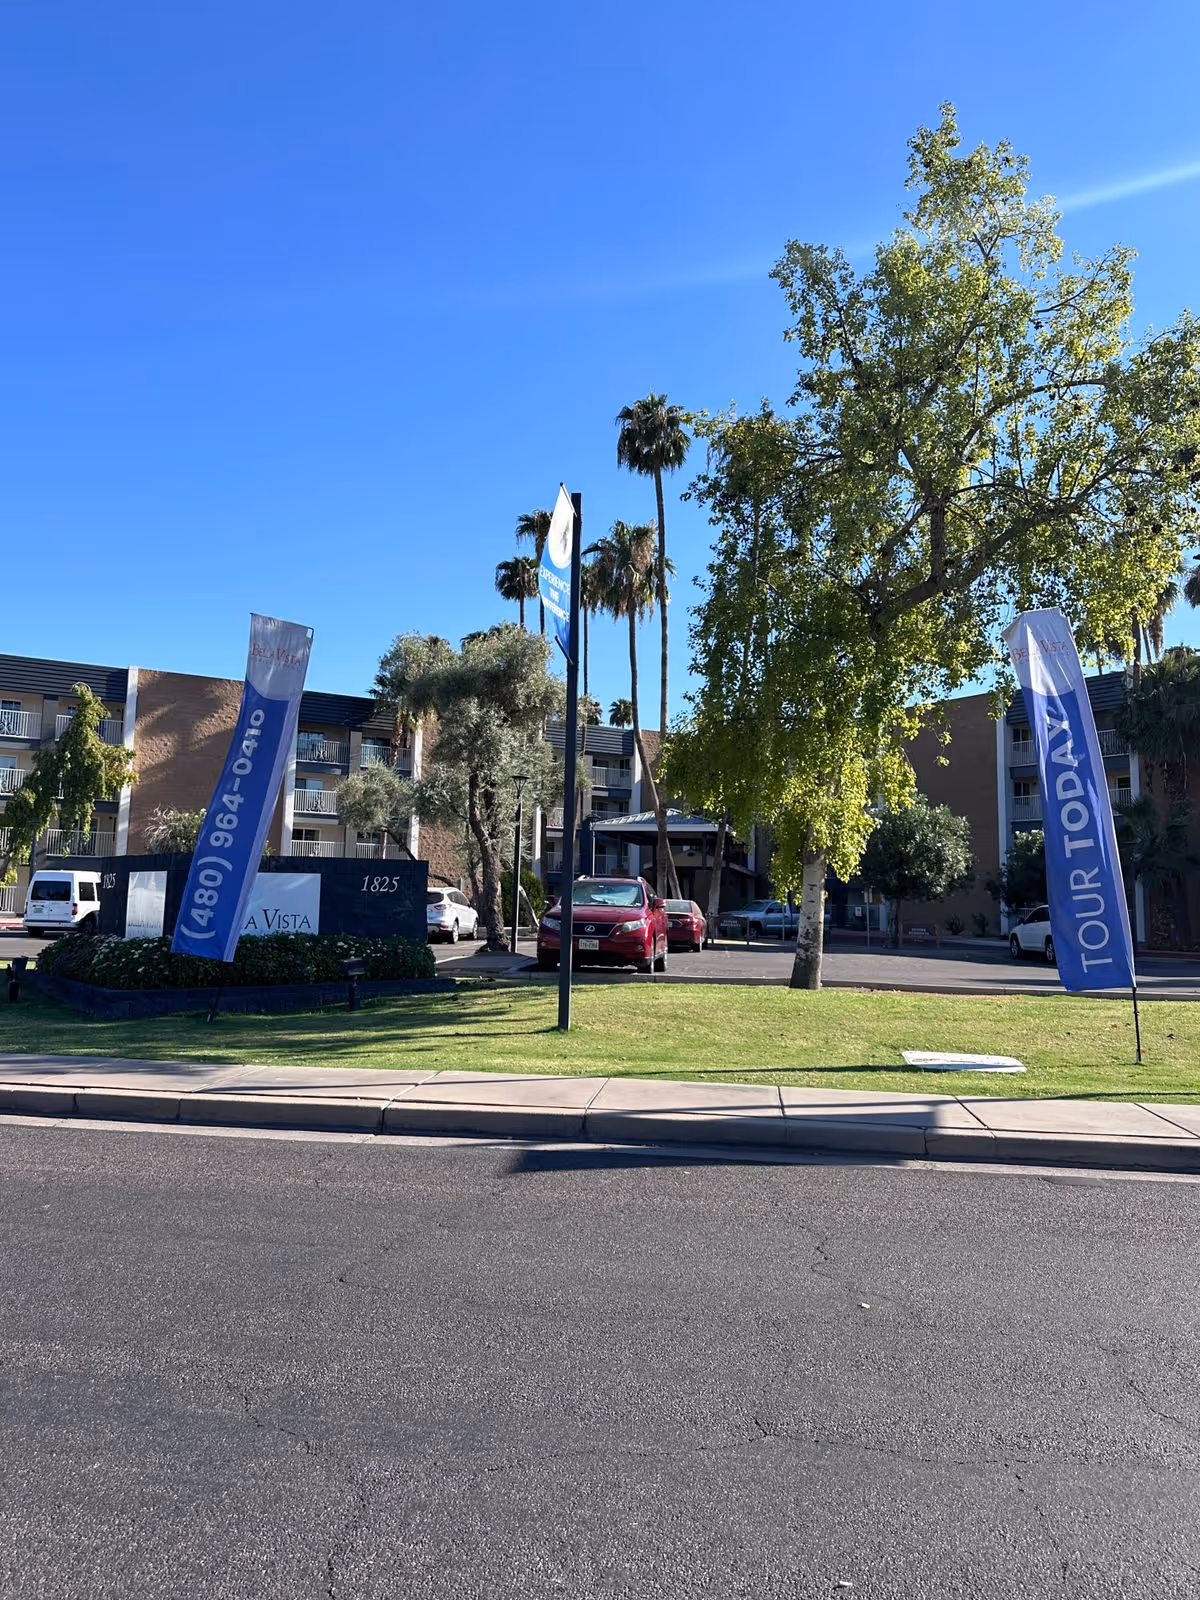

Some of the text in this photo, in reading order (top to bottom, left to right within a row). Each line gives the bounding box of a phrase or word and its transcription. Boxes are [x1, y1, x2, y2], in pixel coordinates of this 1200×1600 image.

[549, 586, 559, 603] THE
[180, 709, 265, 939] (480) 964-0410
[103, 872, 116, 888] 1825
[360, 875, 400, 892] 1825
[262, 908, 311, 929] VISTA
[1069, 866, 1113, 974] TOUR
